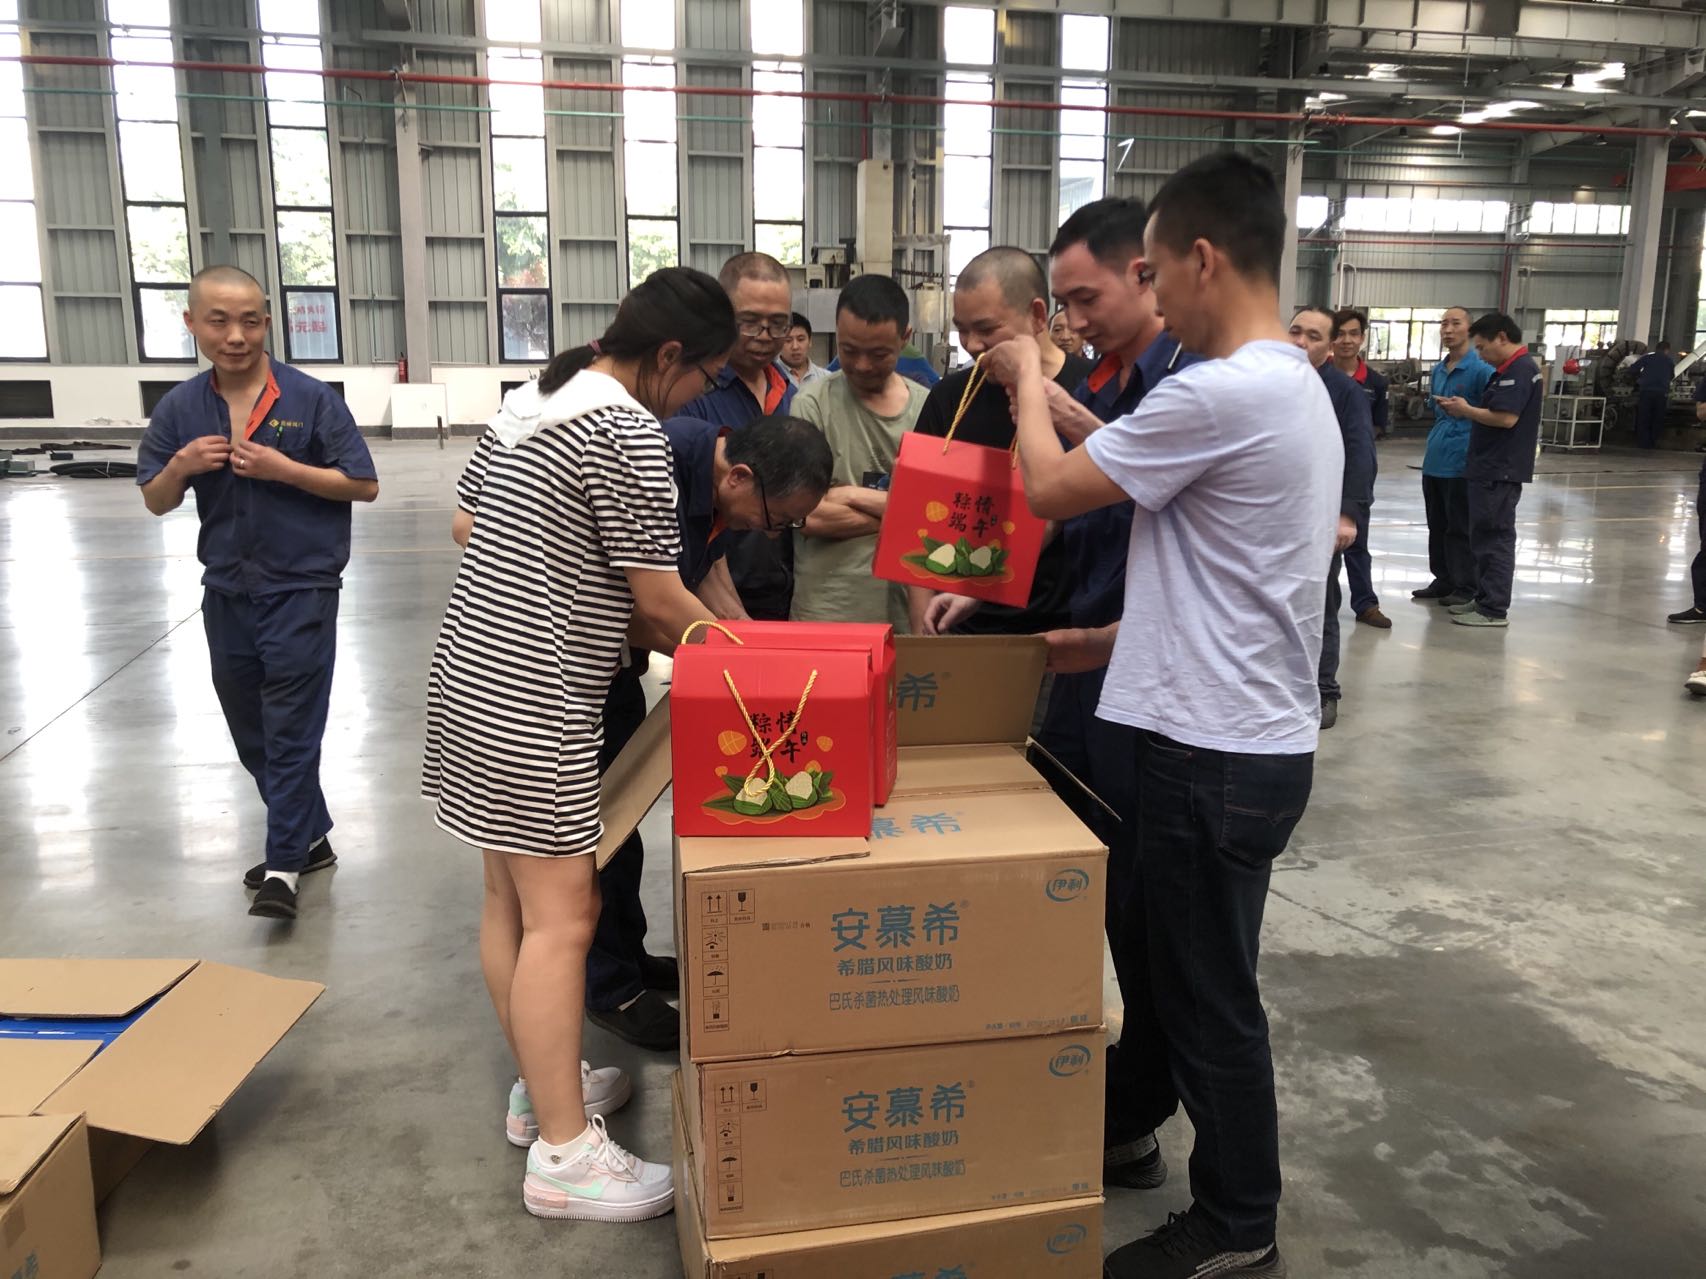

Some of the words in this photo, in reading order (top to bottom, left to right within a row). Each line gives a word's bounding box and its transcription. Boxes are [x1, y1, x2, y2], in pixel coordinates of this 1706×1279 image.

[896, 671, 939, 712] 希
[831, 901, 960, 952] 安慕希
[837, 953, 953, 976] 希腊风味酸奶
[829, 984, 960, 1011] 巴氏杀菌热处理风味酸奶
[841, 1081, 967, 1133] 安慕希
[848, 1130, 959, 1155] 希腊风味酸奶
[839, 1159, 966, 1188] 巴氏杀菌热处理风味酸奶
